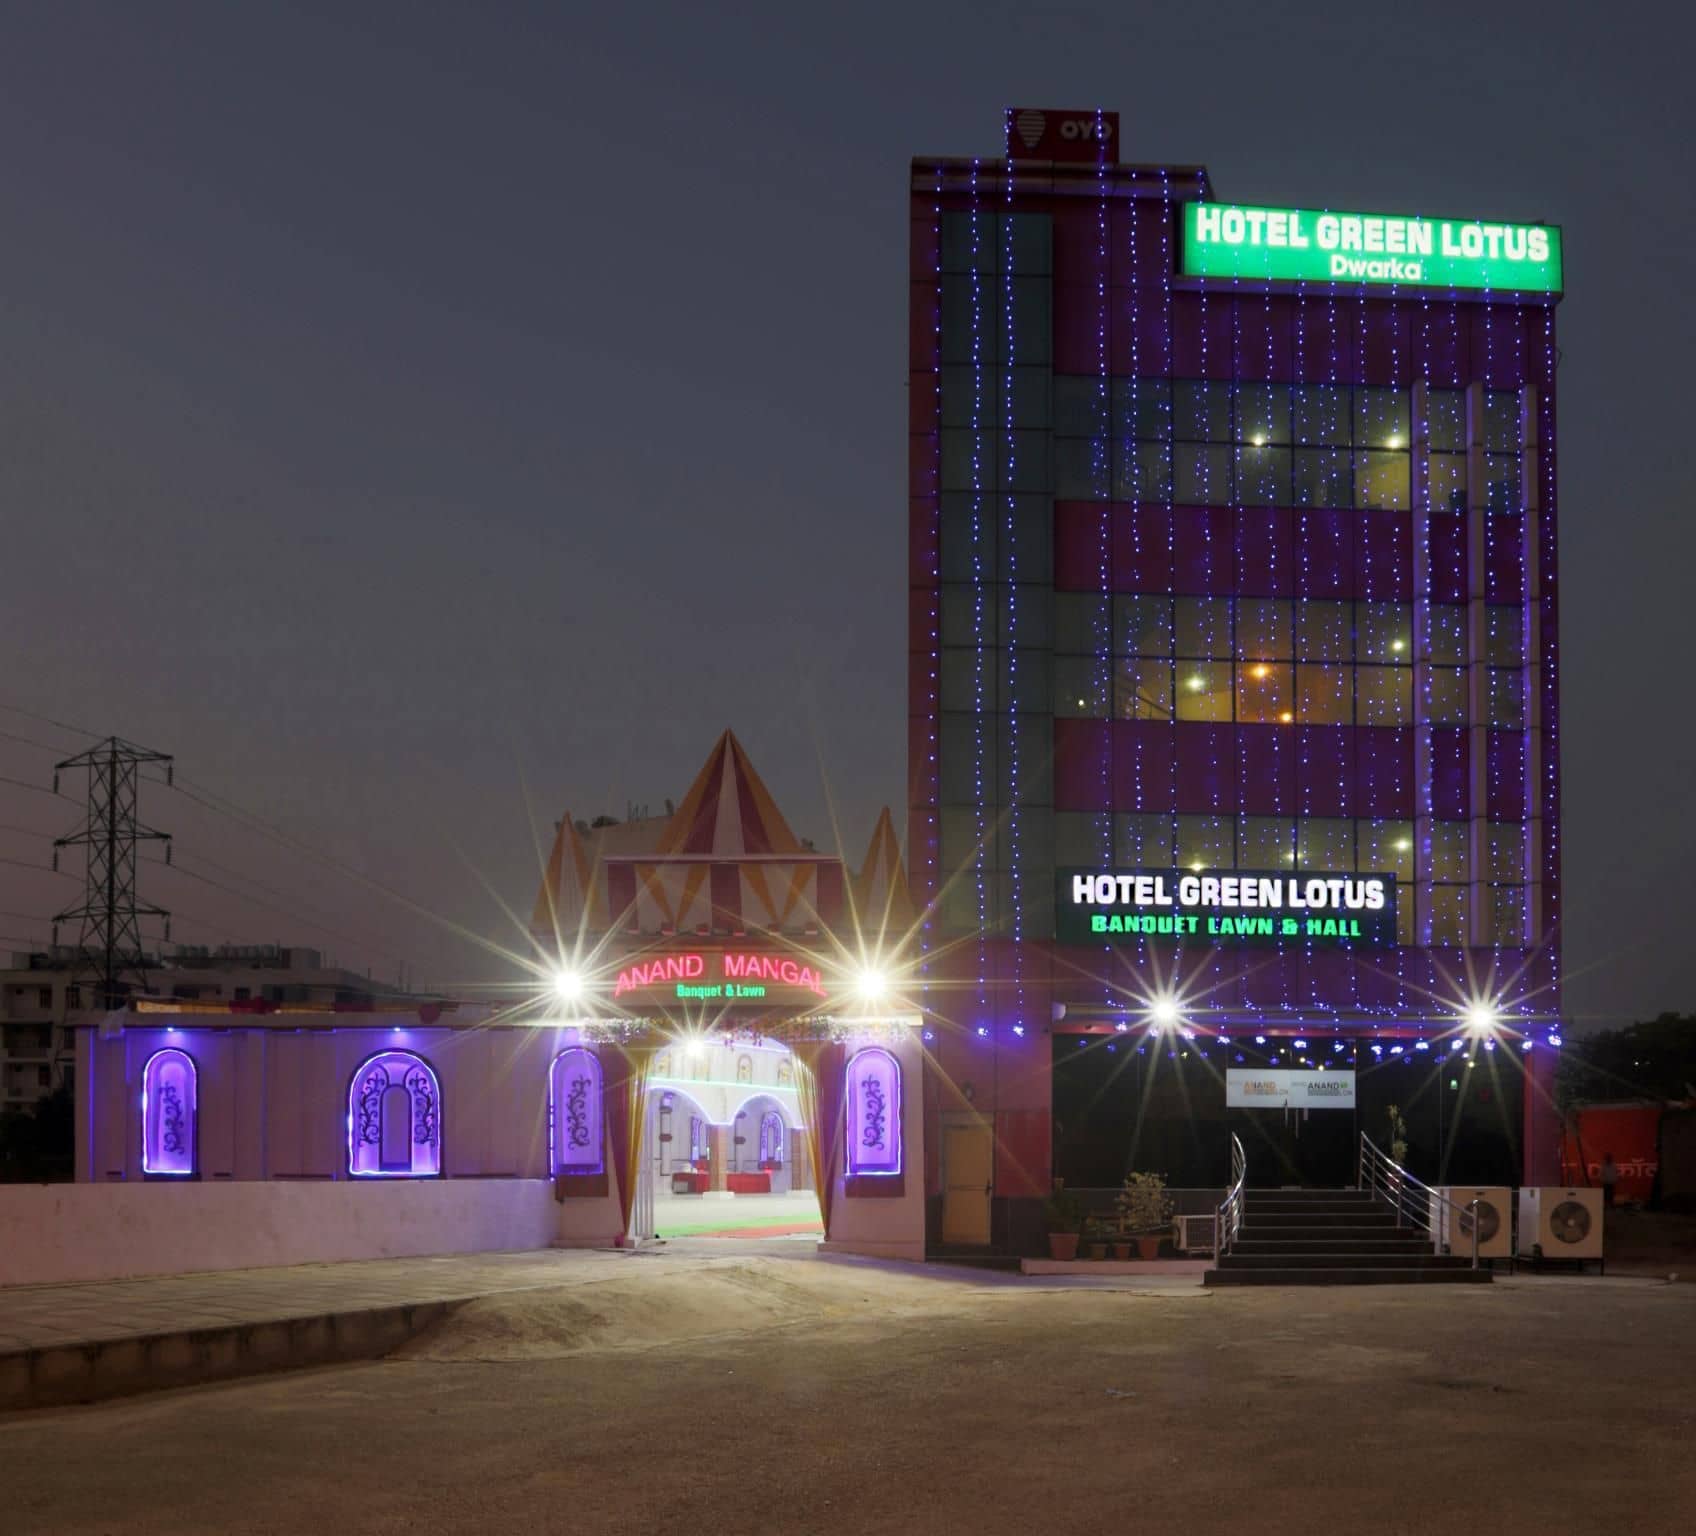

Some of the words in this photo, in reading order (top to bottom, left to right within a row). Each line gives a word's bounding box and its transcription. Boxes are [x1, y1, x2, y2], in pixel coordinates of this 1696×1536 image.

[1061, 120, 1112, 139] OYO
[1196, 207, 1308, 247] HOTEL
[1317, 216, 1432, 254] GREEN
[1442, 223, 1550, 262] LOTUS
[1330, 253, 1421, 280] Dwarka
[1073, 875, 1172, 904] HOTEL
[1180, 876, 1282, 908] GREEN
[1289, 879, 1384, 909] LOTUS
[1091, 914, 1199, 933] BANQUET
[1208, 916, 1273, 935] LAWN
[1282, 918, 1298, 935] &
[1307, 919, 1361, 936] HALL
[615, 954, 704, 997] ANAND
[724, 954, 828, 997] MANGAL
[677, 984, 721, 1000] Banquet
[726, 984, 734, 998] &
[737, 984, 765, 998] Lawn
[1308, 1081, 1339, 1089] ANAND
